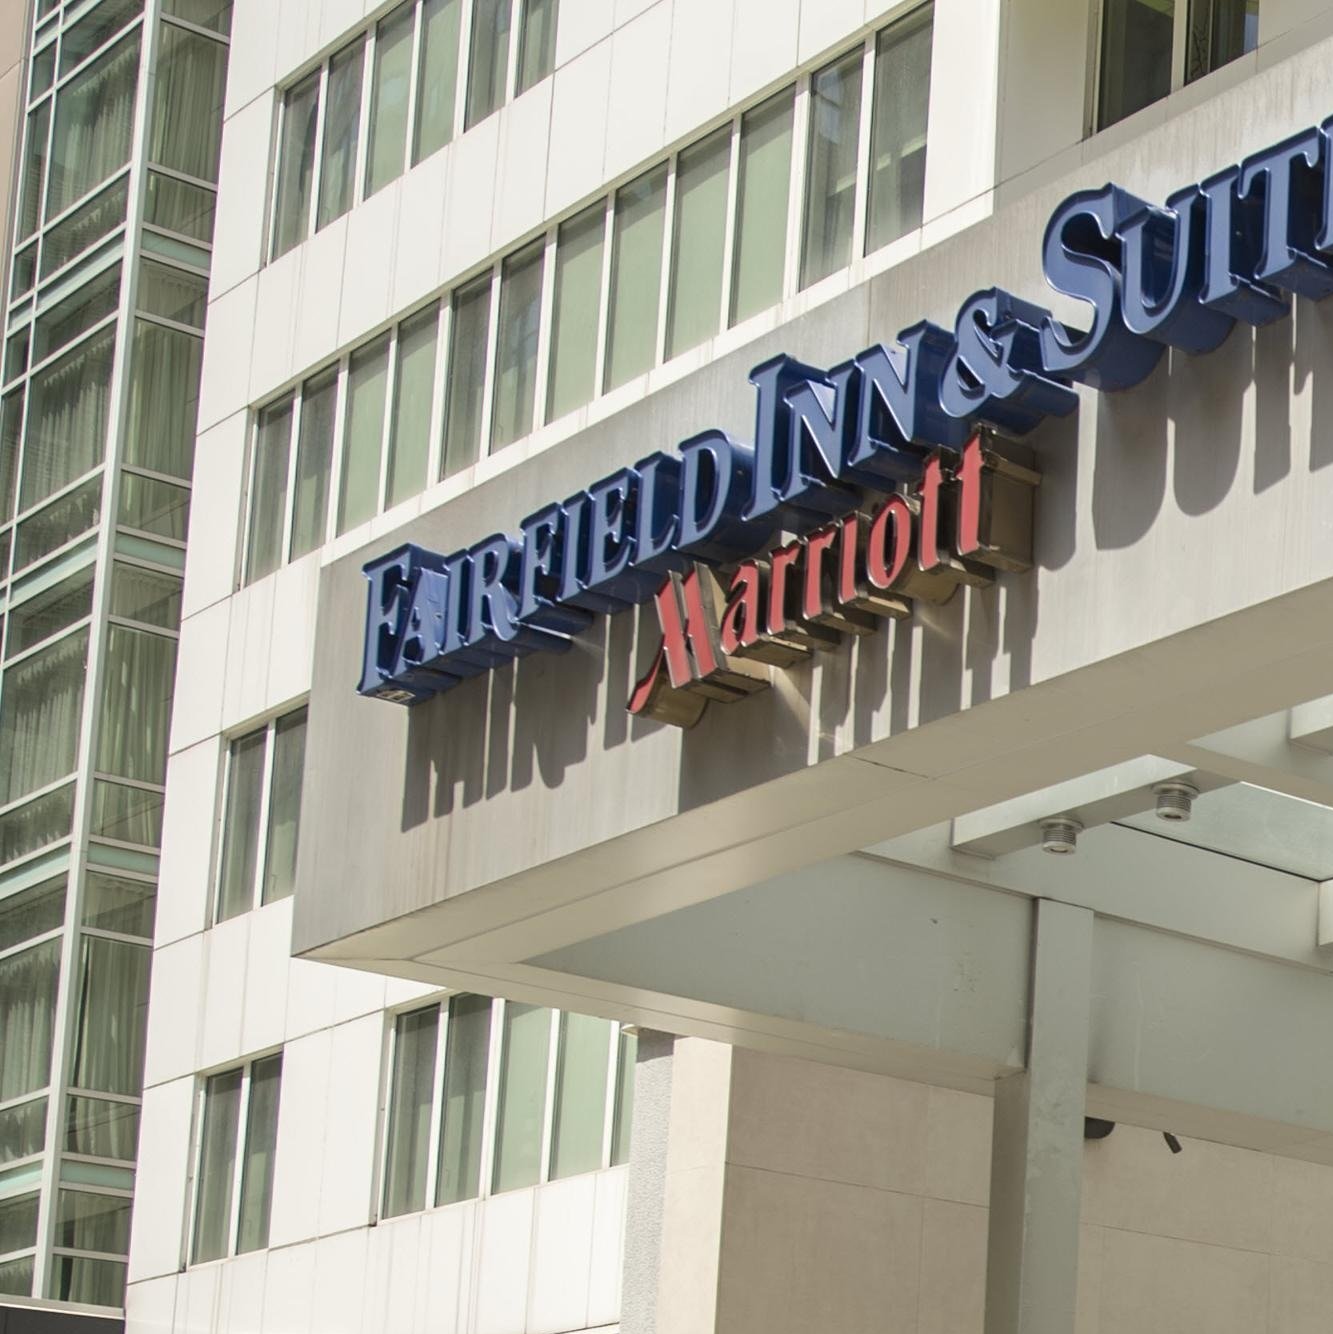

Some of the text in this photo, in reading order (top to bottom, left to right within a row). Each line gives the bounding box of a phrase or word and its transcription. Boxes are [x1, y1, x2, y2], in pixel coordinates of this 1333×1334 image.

[360, 428, 758, 702] FAIRFIELD
[744, 318, 952, 522] INN
[938, 286, 1070, 420] &
[626, 424, 1042, 728] Marriott
